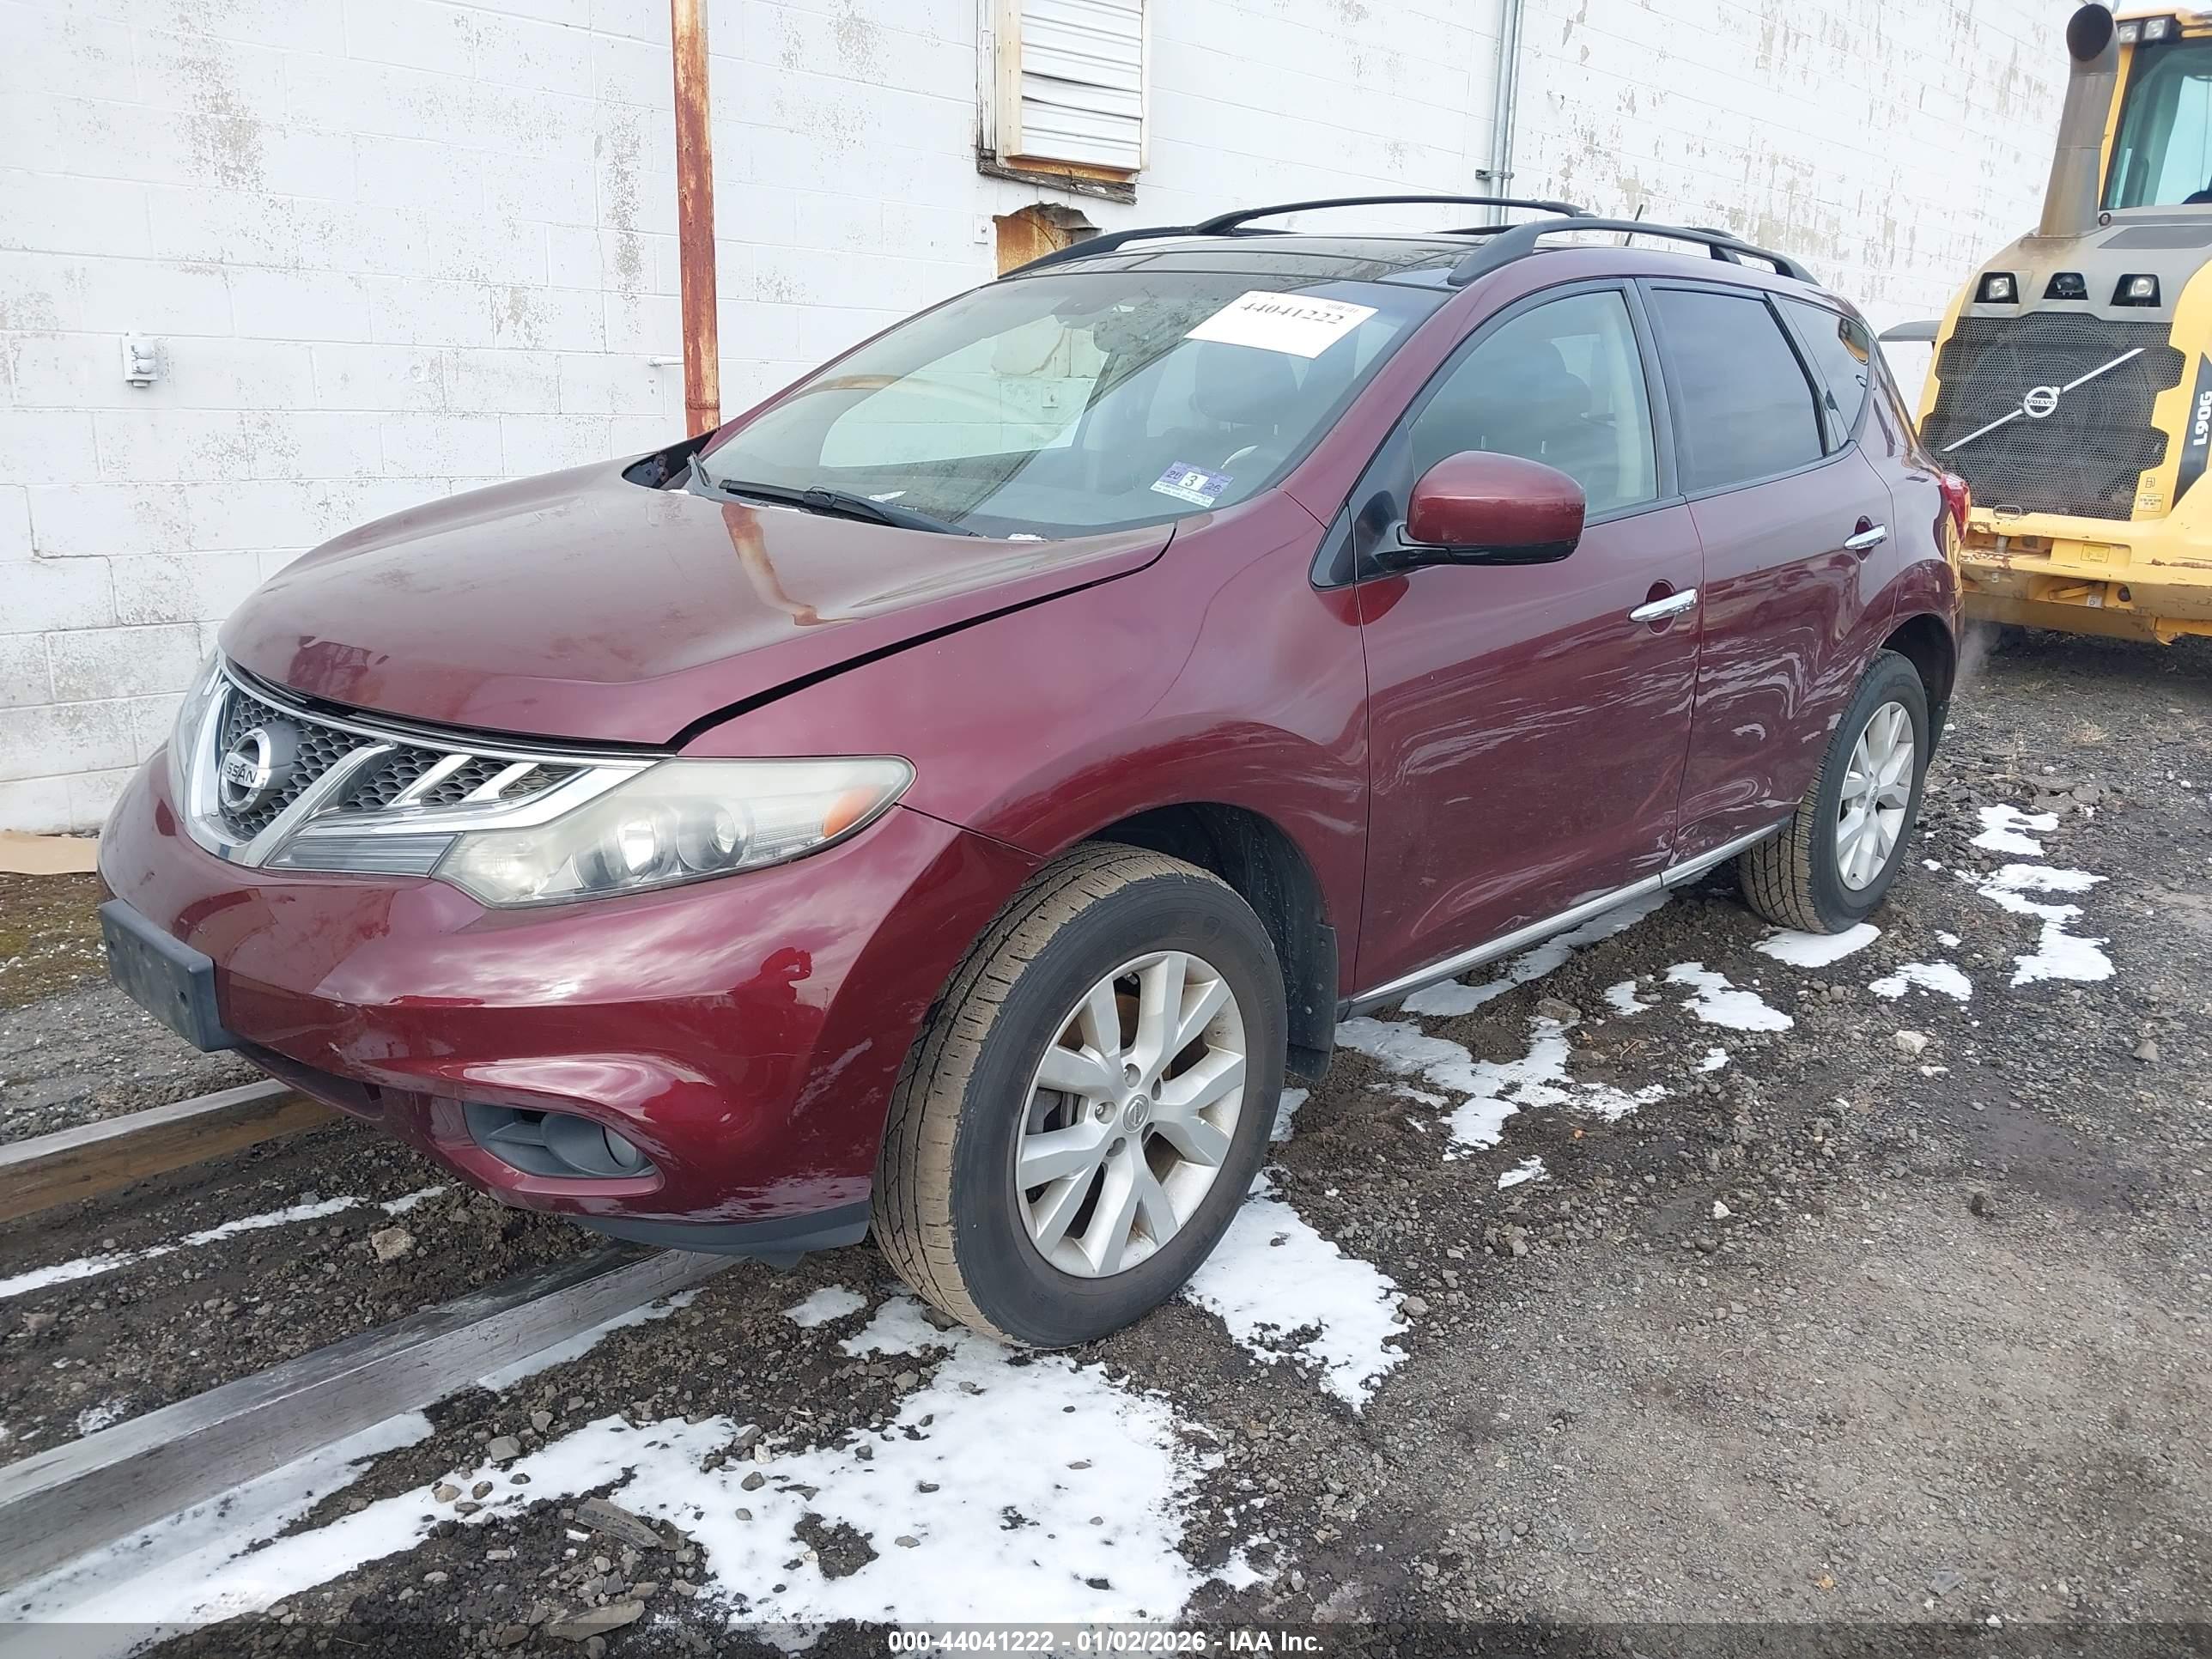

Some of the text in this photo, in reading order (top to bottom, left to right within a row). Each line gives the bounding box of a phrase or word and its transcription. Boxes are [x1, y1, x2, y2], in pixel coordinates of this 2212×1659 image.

[1240, 302, 1345, 325] 44041222
[2192, 391, 2212, 447] L90G
[1184, 475, 1199, 487] 3
